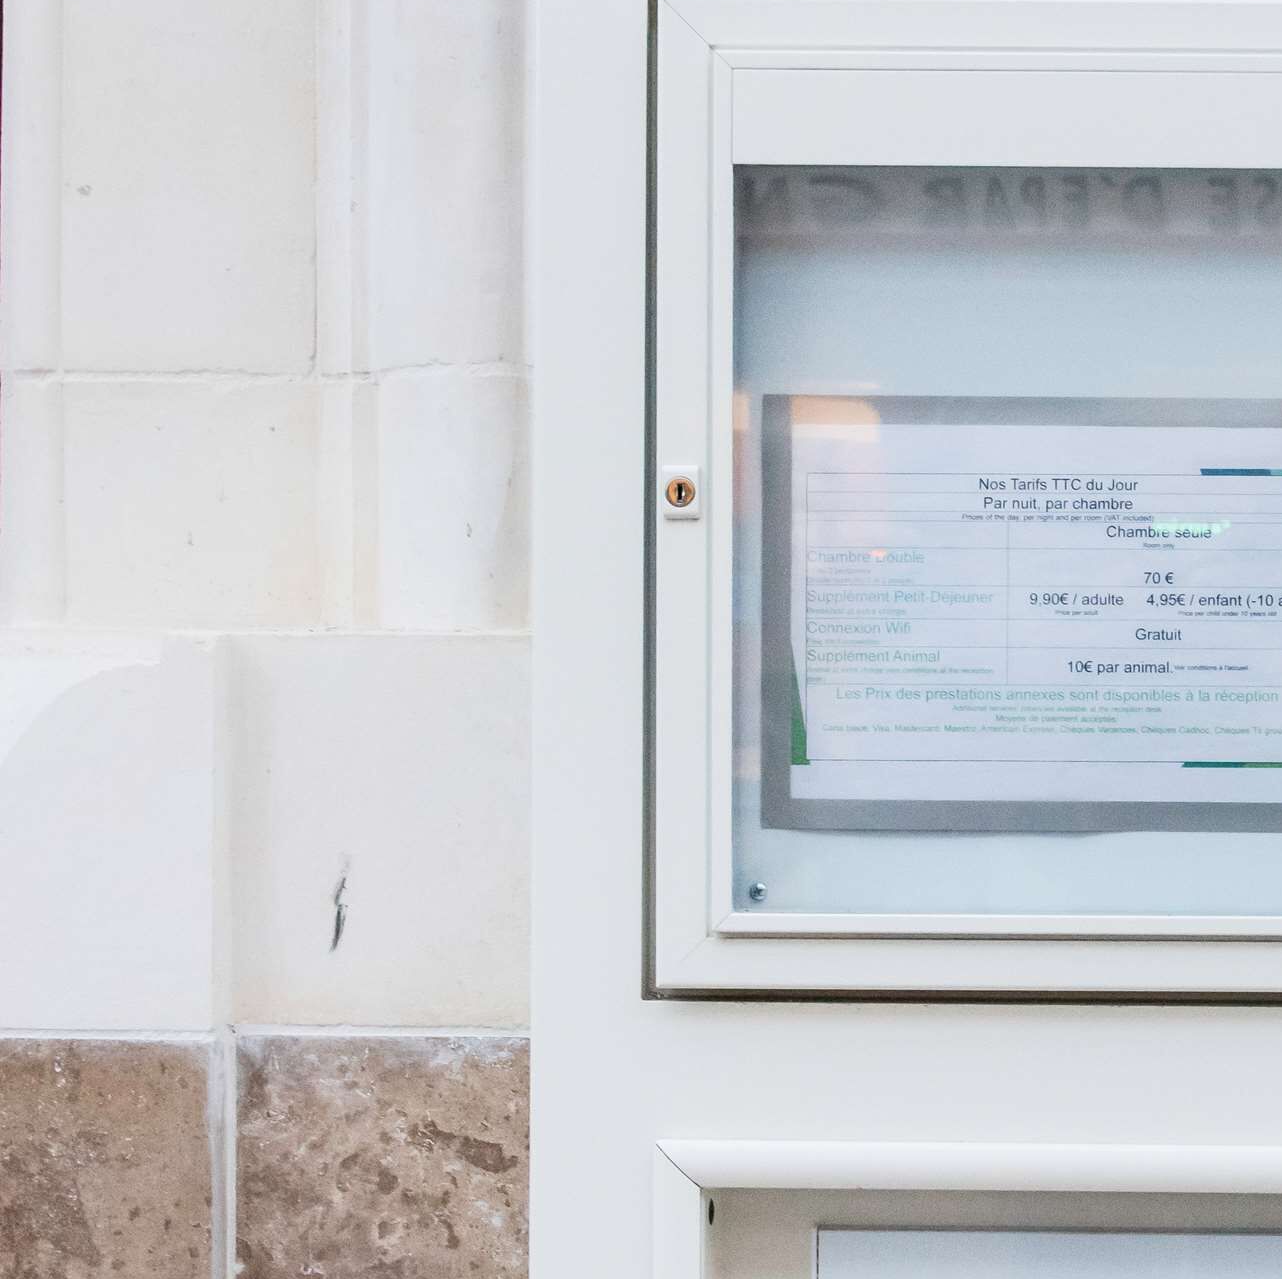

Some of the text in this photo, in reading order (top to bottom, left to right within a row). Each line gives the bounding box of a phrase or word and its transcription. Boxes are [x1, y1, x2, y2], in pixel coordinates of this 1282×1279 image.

[978, 477, 1138, 491] Nos Tarifs TTC du Jour
[983, 496, 1007, 510] Par
[1046, 499, 1069, 512] par
[1072, 497, 1133, 510] chambre
[1106, 524, 1170, 539] Chambre
[807, 550, 871, 563] Chambre
[1144, 571, 1174, 584] 70 €
[1029, 593, 1069, 607] 9,90€
[1081, 593, 1124, 606] adulte
[1146, 594, 1186, 608] 4,95€
[1199, 594, 1242, 607] enfant
[1246, 594, 1274, 608] (-10
[807, 621, 911, 634] Connexion Wifi
[1135, 628, 1182, 641] Gratuit
[893, 649, 940, 662] Animal
[1067, 661, 1093, 673] 10€
[1097, 664, 1121, 676] par
[836, 687, 1279, 705] Les Prix des prestations annexes sont disponibles à la réception
